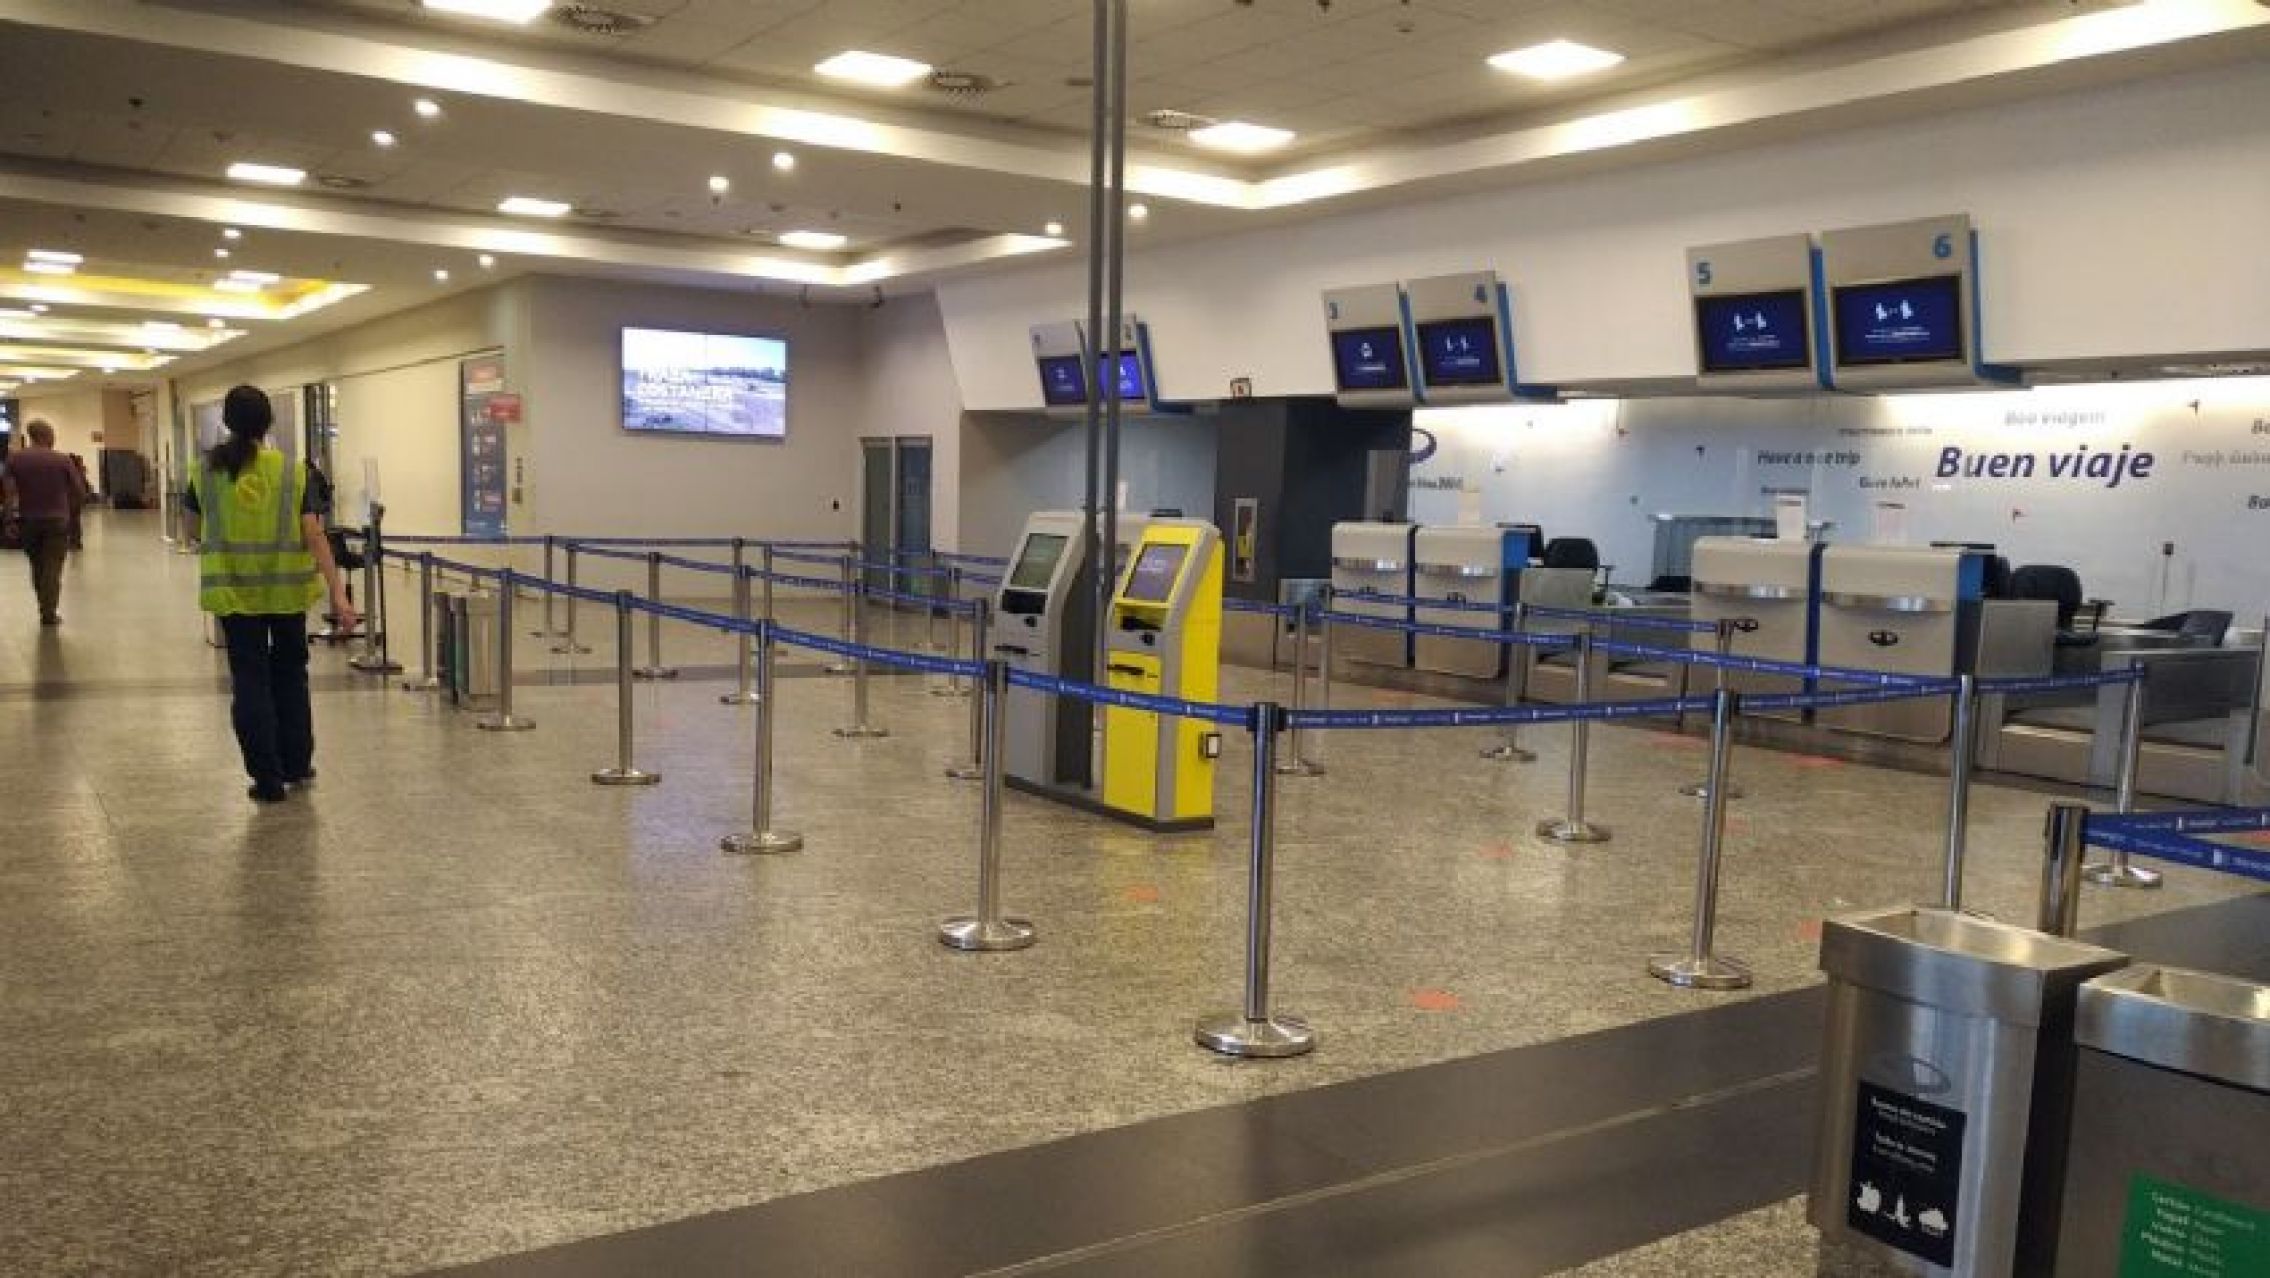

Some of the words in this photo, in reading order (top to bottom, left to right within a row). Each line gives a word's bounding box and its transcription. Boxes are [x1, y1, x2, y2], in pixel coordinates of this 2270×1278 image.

[1934, 236, 1951, 258] 6
[1696, 262, 1711, 284] 5
[1936, 446, 2036, 478] Buen
[2049, 442, 2155, 488] viaje
